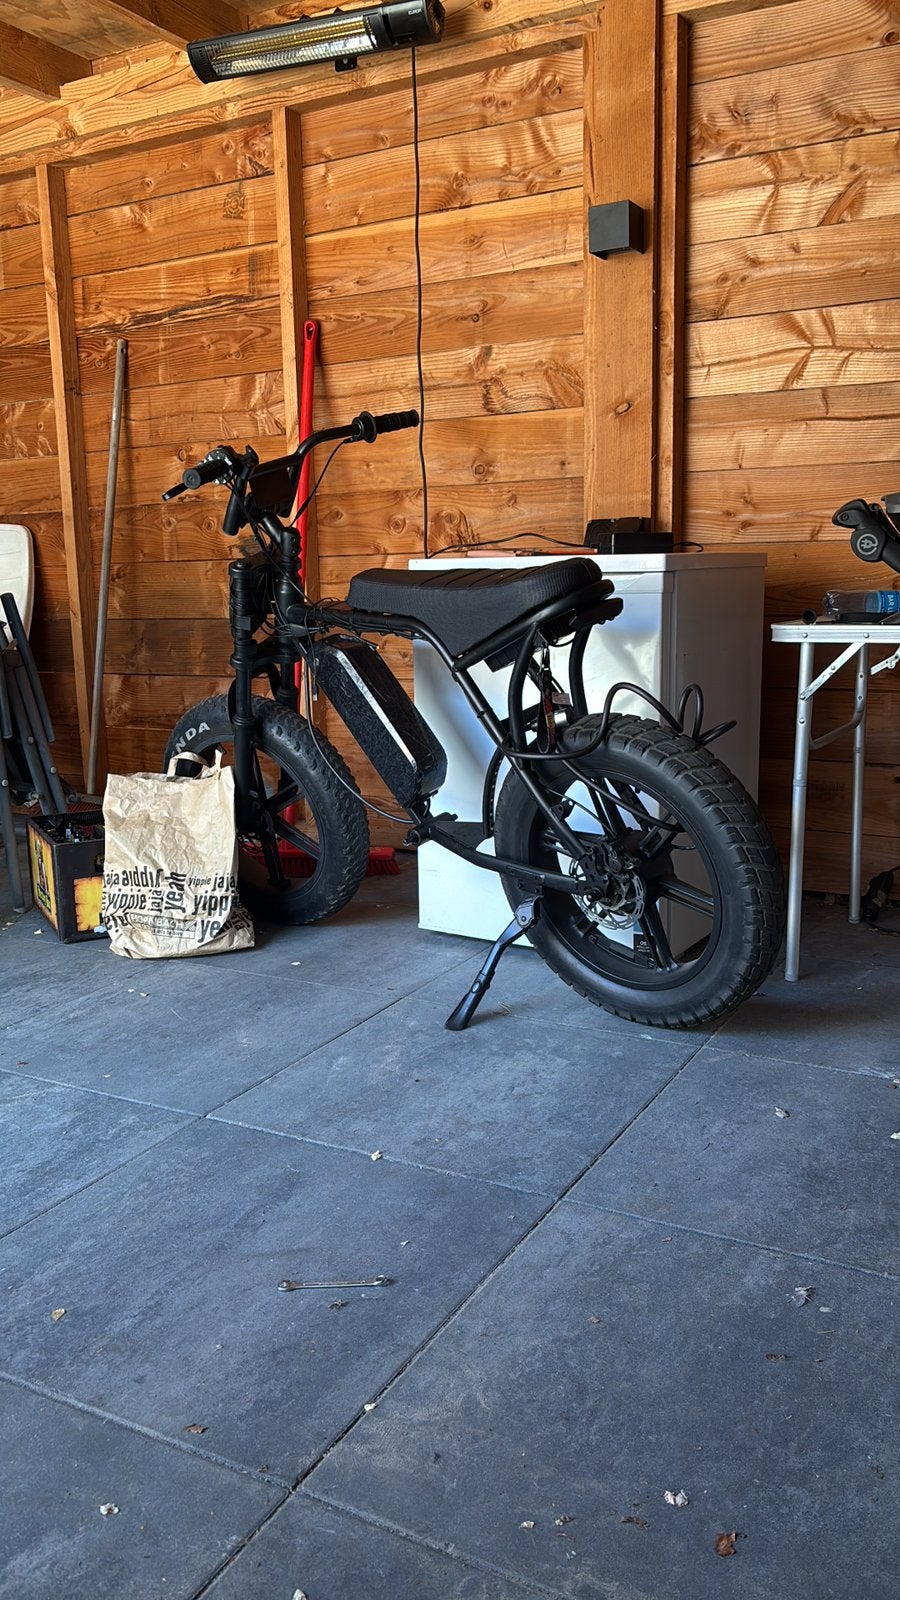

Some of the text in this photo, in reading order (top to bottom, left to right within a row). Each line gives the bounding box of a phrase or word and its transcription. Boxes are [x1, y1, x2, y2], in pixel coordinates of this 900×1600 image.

[171, 722, 211, 757] NDA
[164, 872, 187, 914] yeah
[188, 876, 212, 887] yippie
[212, 873, 236, 892] jaja
[106, 888, 147, 914] yippie
[148, 889, 164, 913] jaja
